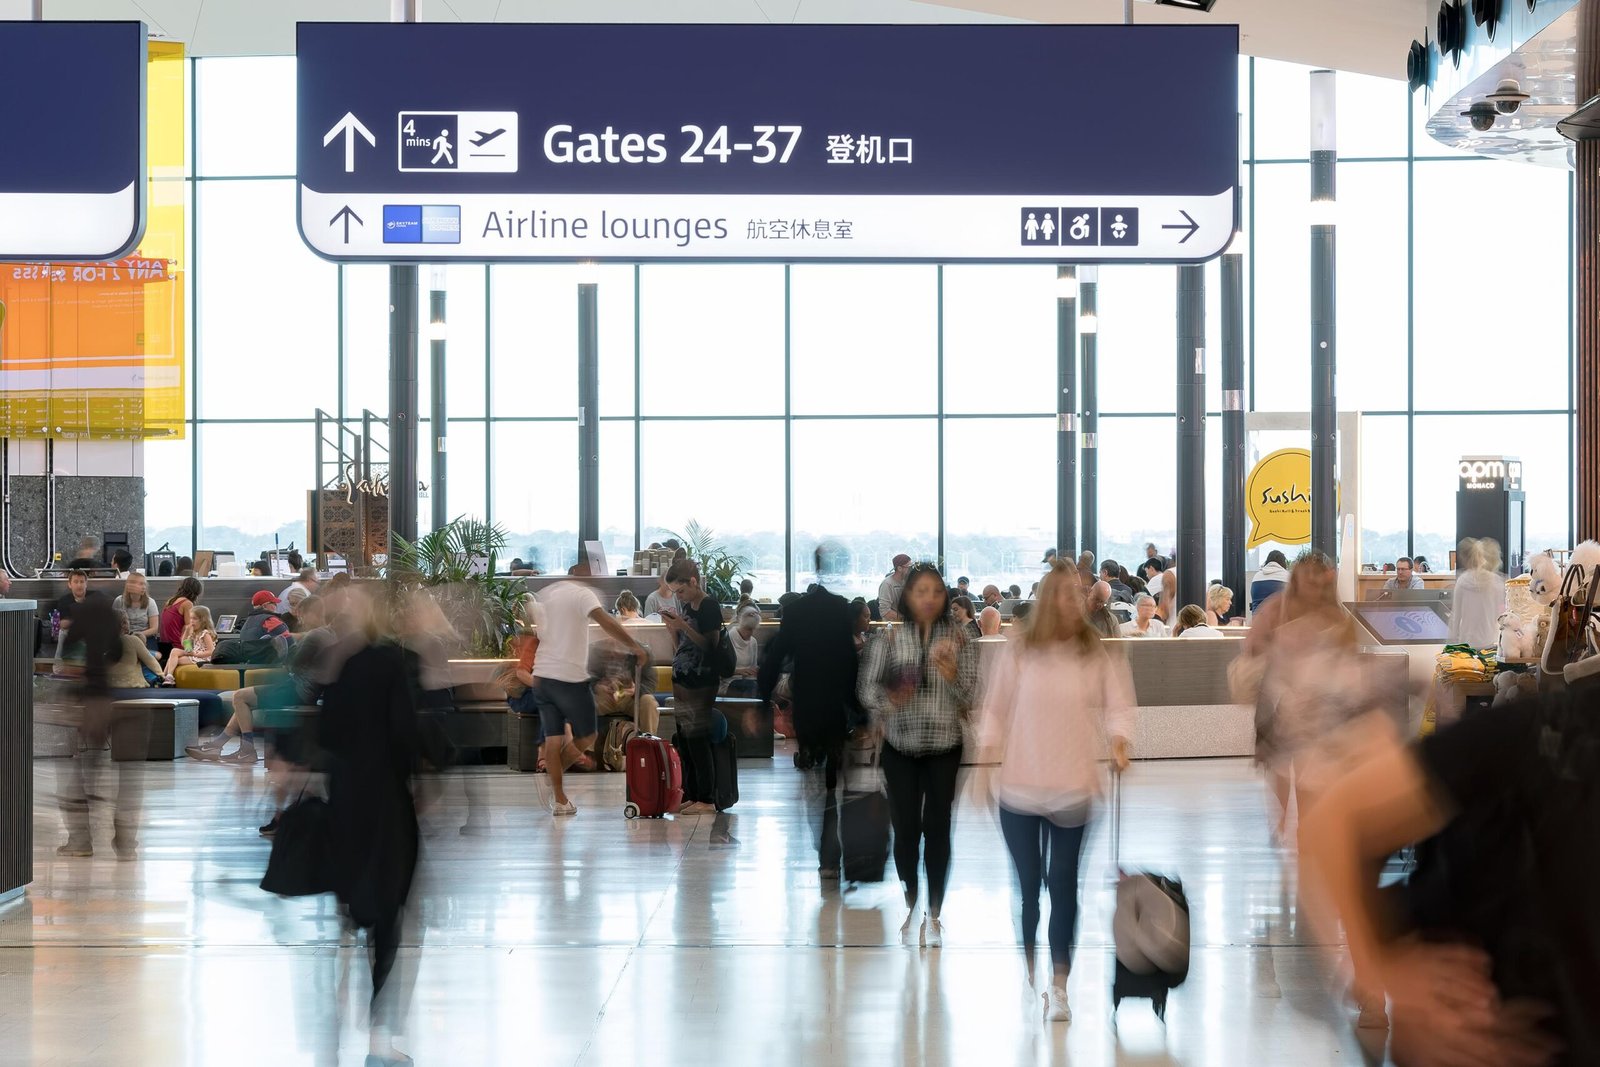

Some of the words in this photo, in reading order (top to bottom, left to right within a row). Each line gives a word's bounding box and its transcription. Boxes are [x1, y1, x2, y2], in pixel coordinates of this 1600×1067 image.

[403, 120, 416, 136] 4
[406, 138, 431, 147] mins
[543, 124, 668, 164] Gates
[679, 125, 803, 164] 24-37
[825, 134, 914, 164] 登机口
[481, 209, 588, 239] Airline
[602, 209, 729, 247] lounges
[746, 218, 854, 240] 航空休息室
